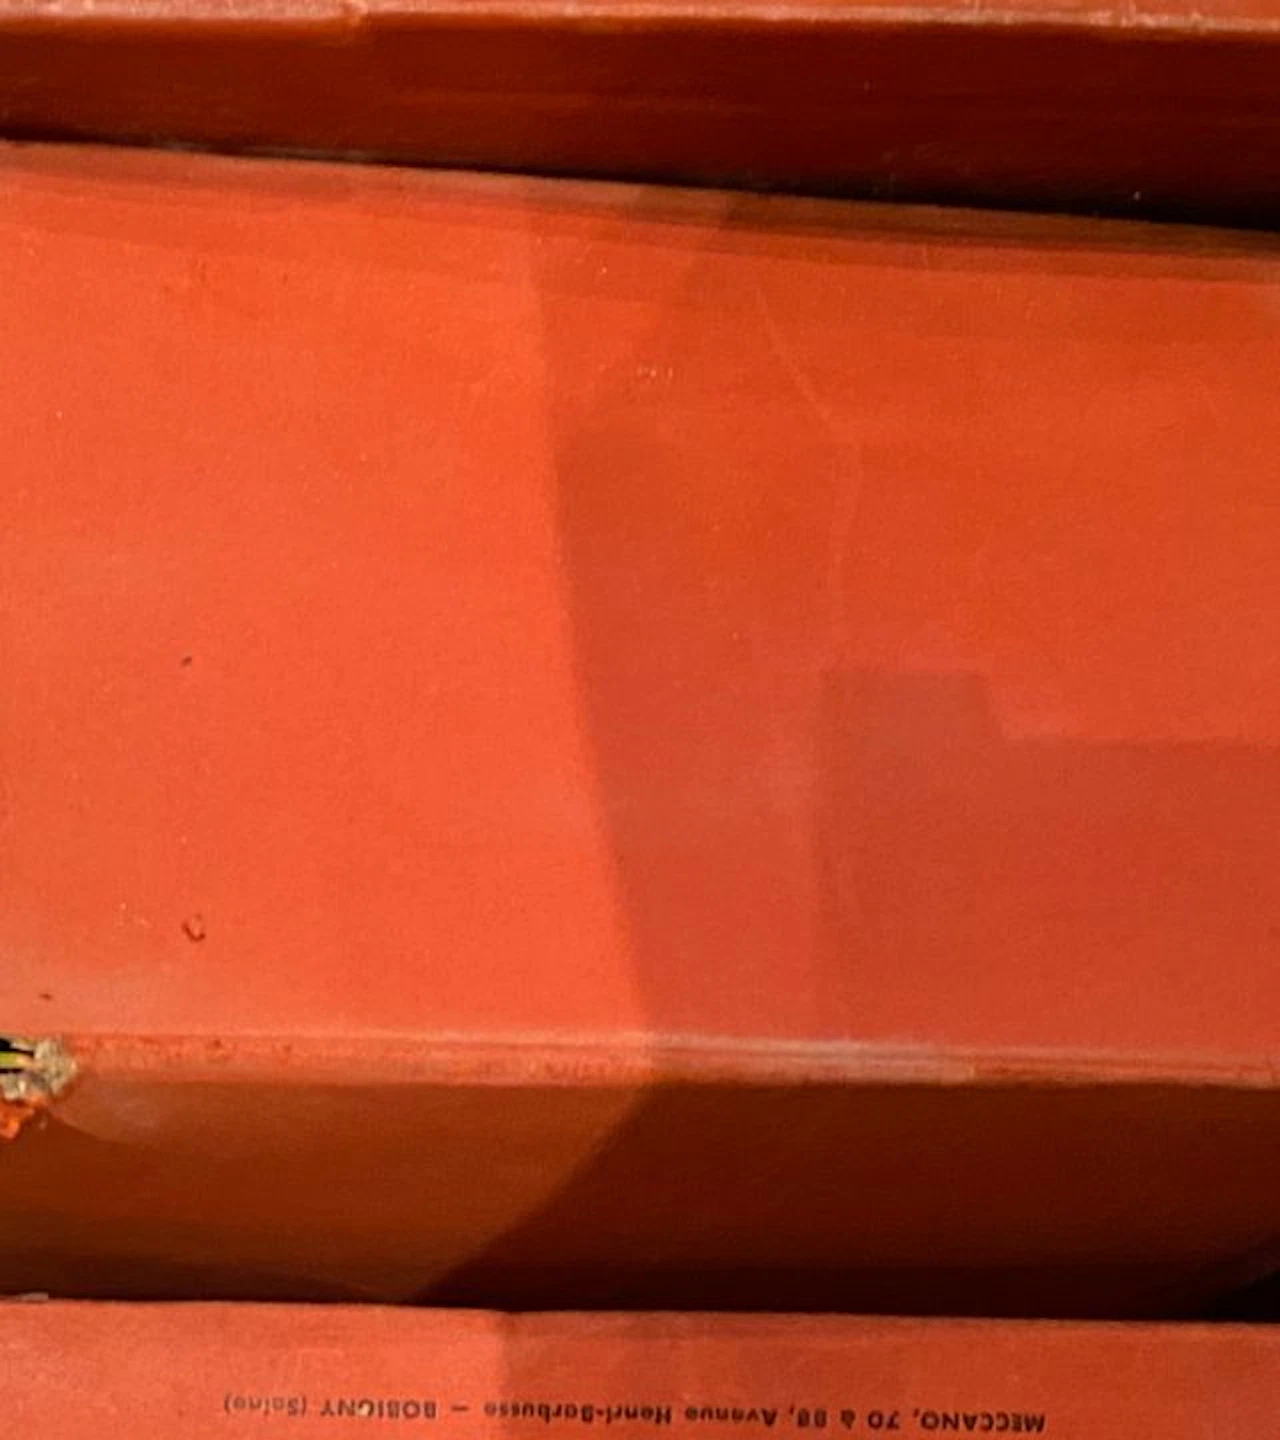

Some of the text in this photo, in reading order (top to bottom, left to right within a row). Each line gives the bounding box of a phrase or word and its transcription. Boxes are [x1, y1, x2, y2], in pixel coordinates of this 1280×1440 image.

[319, 1398, 437, 1420] BOBIGNY
[483, 1401, 671, 1426] Henri-Barbusse
[684, 1406, 779, 1427] Avenue
[867, 1409, 901, 1431] 70
[913, 1408, 1046, 1434] MECCANO,
